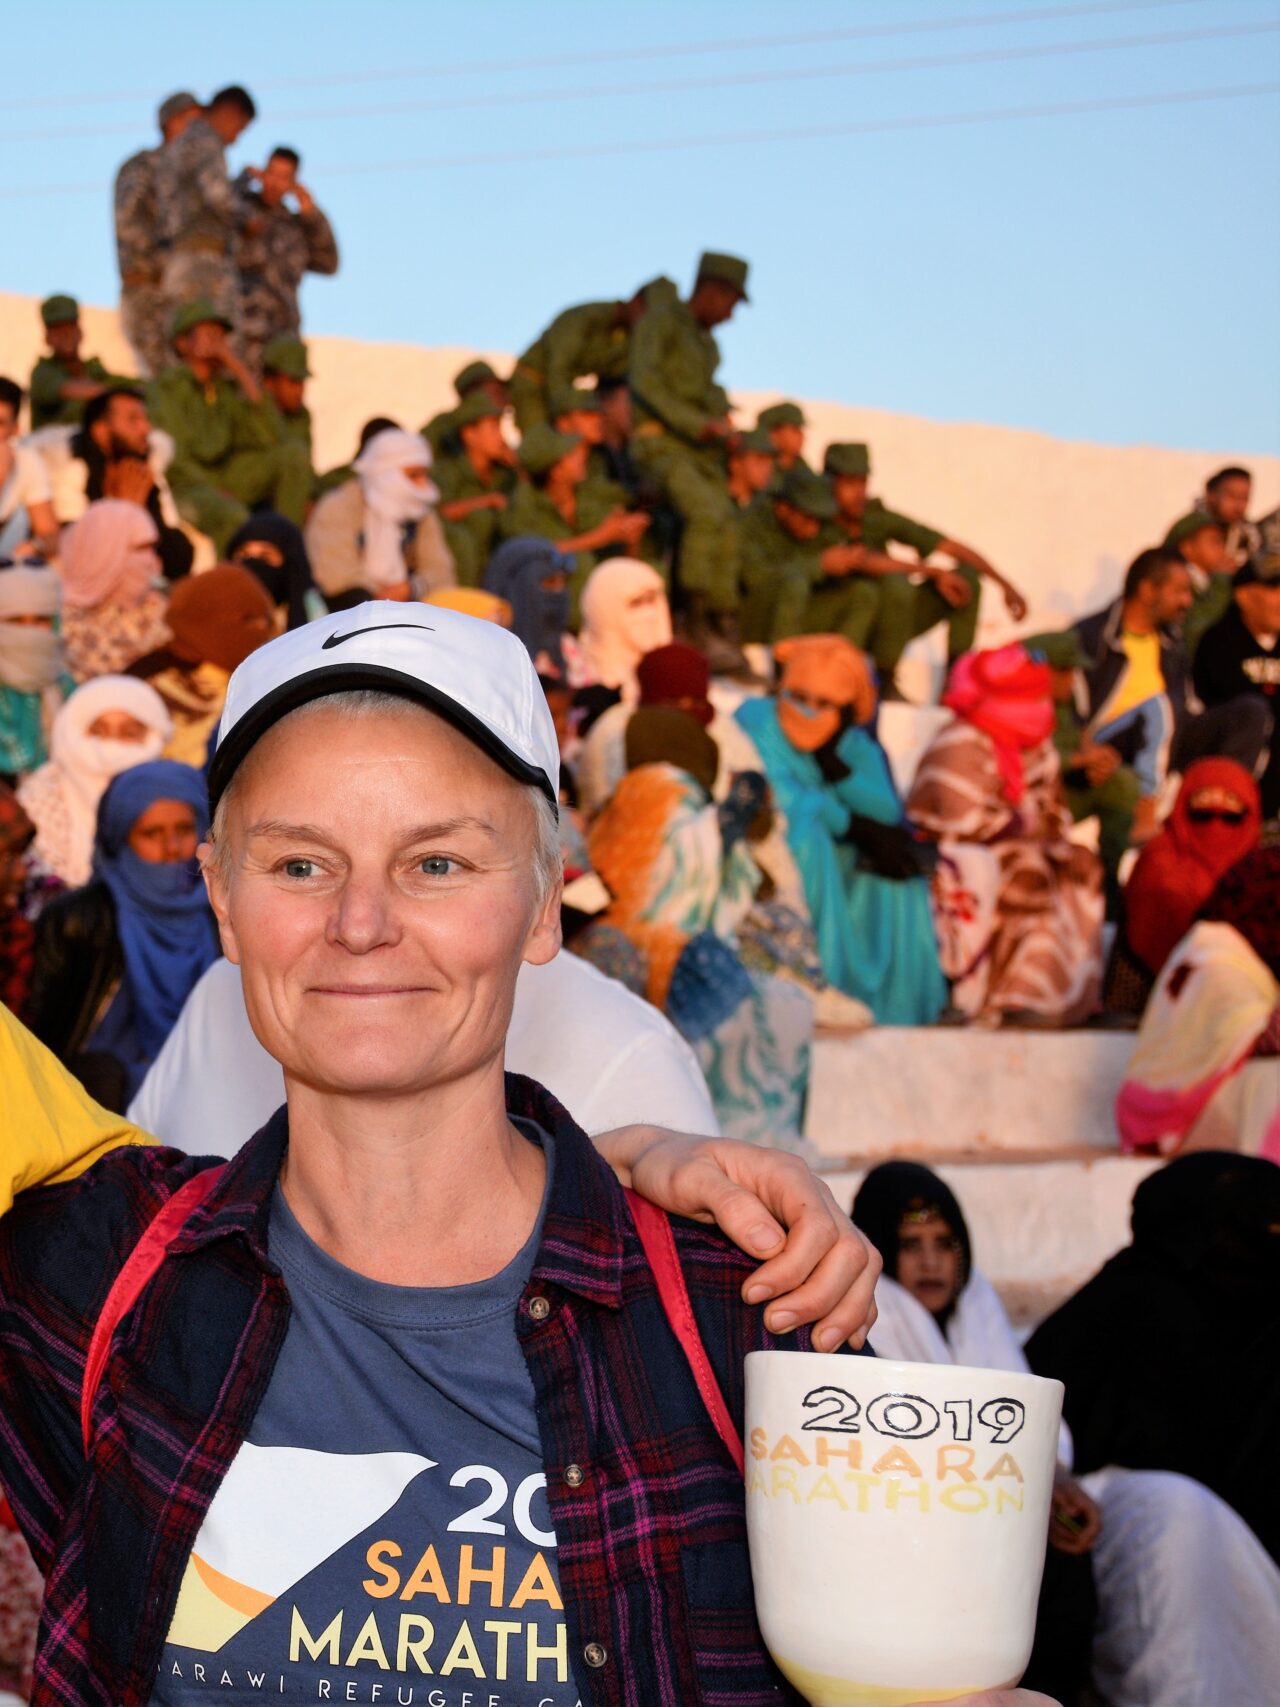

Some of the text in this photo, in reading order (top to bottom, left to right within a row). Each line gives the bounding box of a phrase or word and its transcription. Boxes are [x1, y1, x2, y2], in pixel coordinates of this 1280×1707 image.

[802, 1386, 1025, 1443] 2019
[750, 1426, 1025, 1483] SAHARA
[362, 1540, 565, 1610] SAHA
[289, 1604, 568, 1682] MARATH
[157, 1660, 285, 1693] ARAWI
